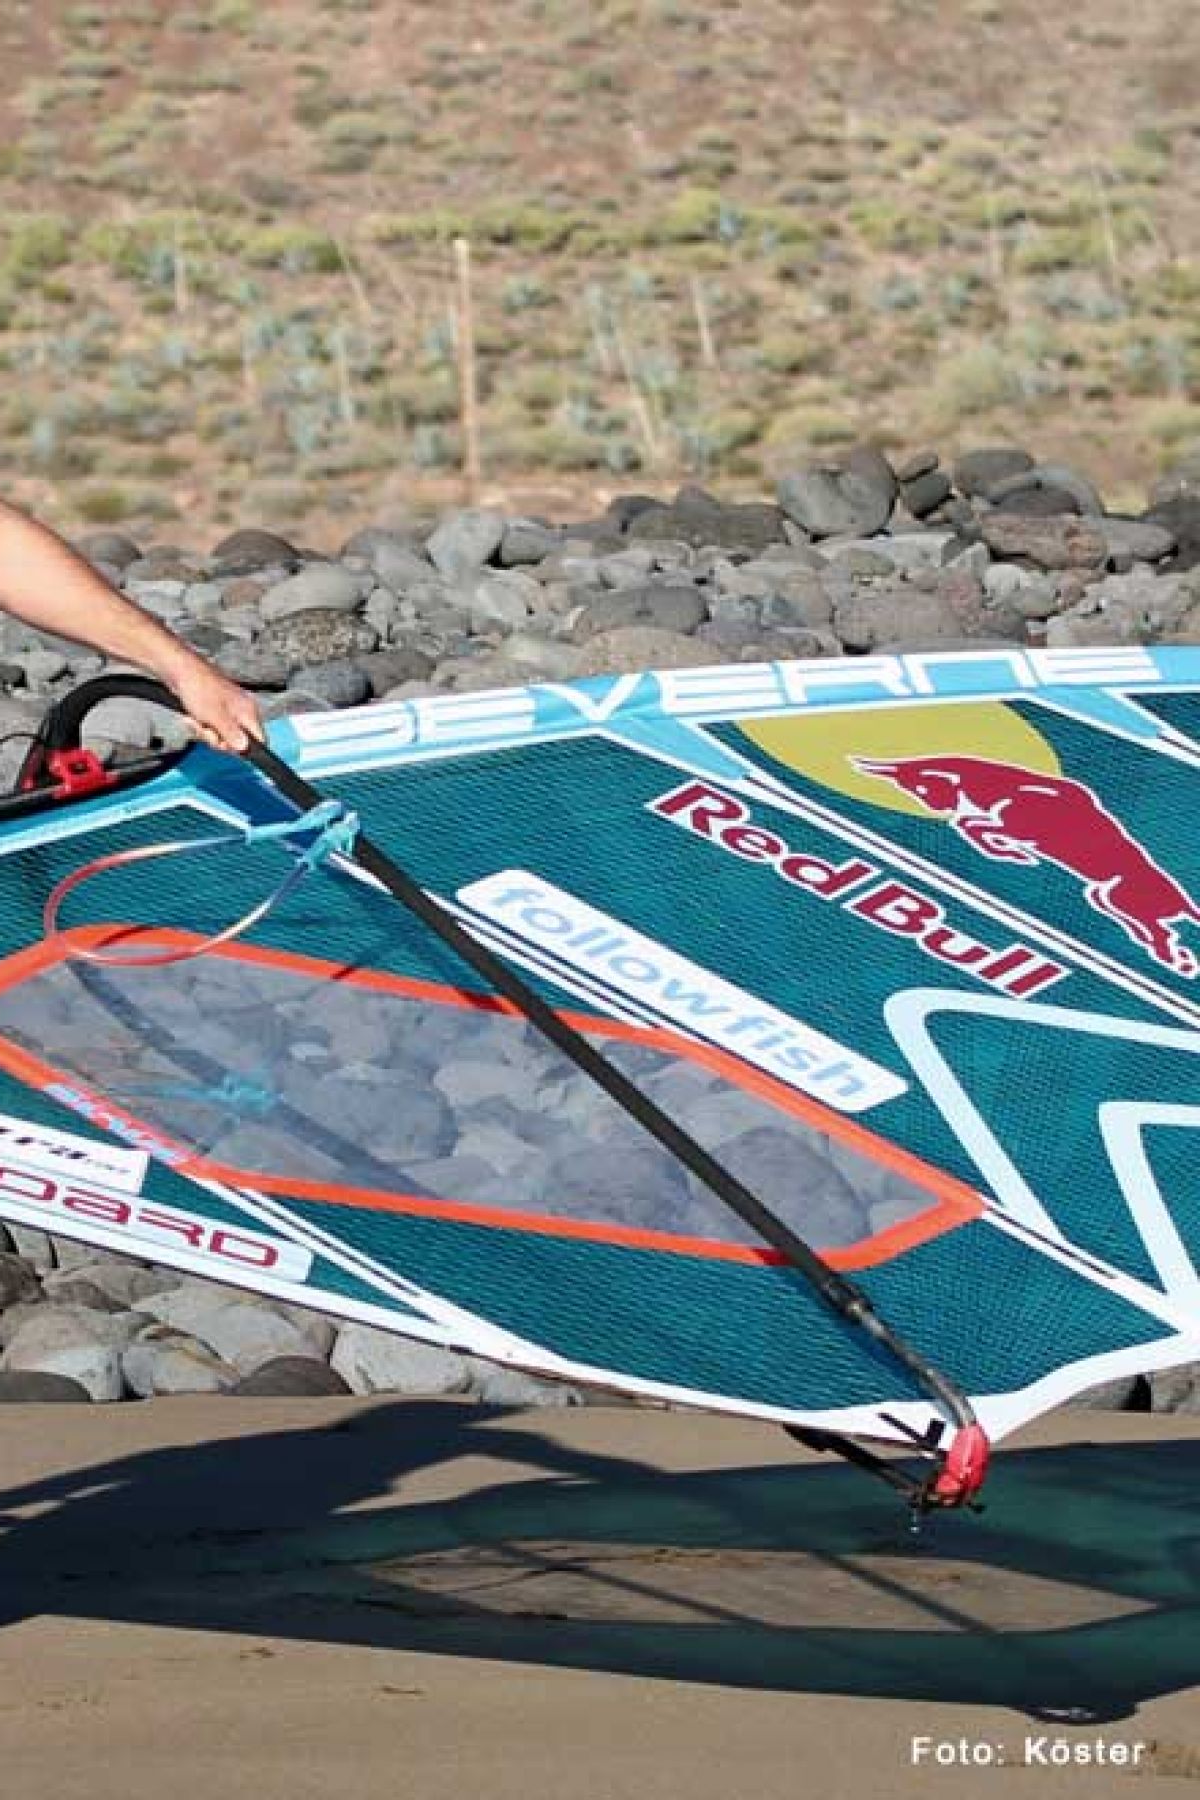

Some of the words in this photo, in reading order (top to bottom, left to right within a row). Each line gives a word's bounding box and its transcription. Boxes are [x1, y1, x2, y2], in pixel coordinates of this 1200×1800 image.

[289, 646, 1163, 764] SEVERNE
[651, 781, 876, 898] Red
[848, 880, 1068, 998] Bull
